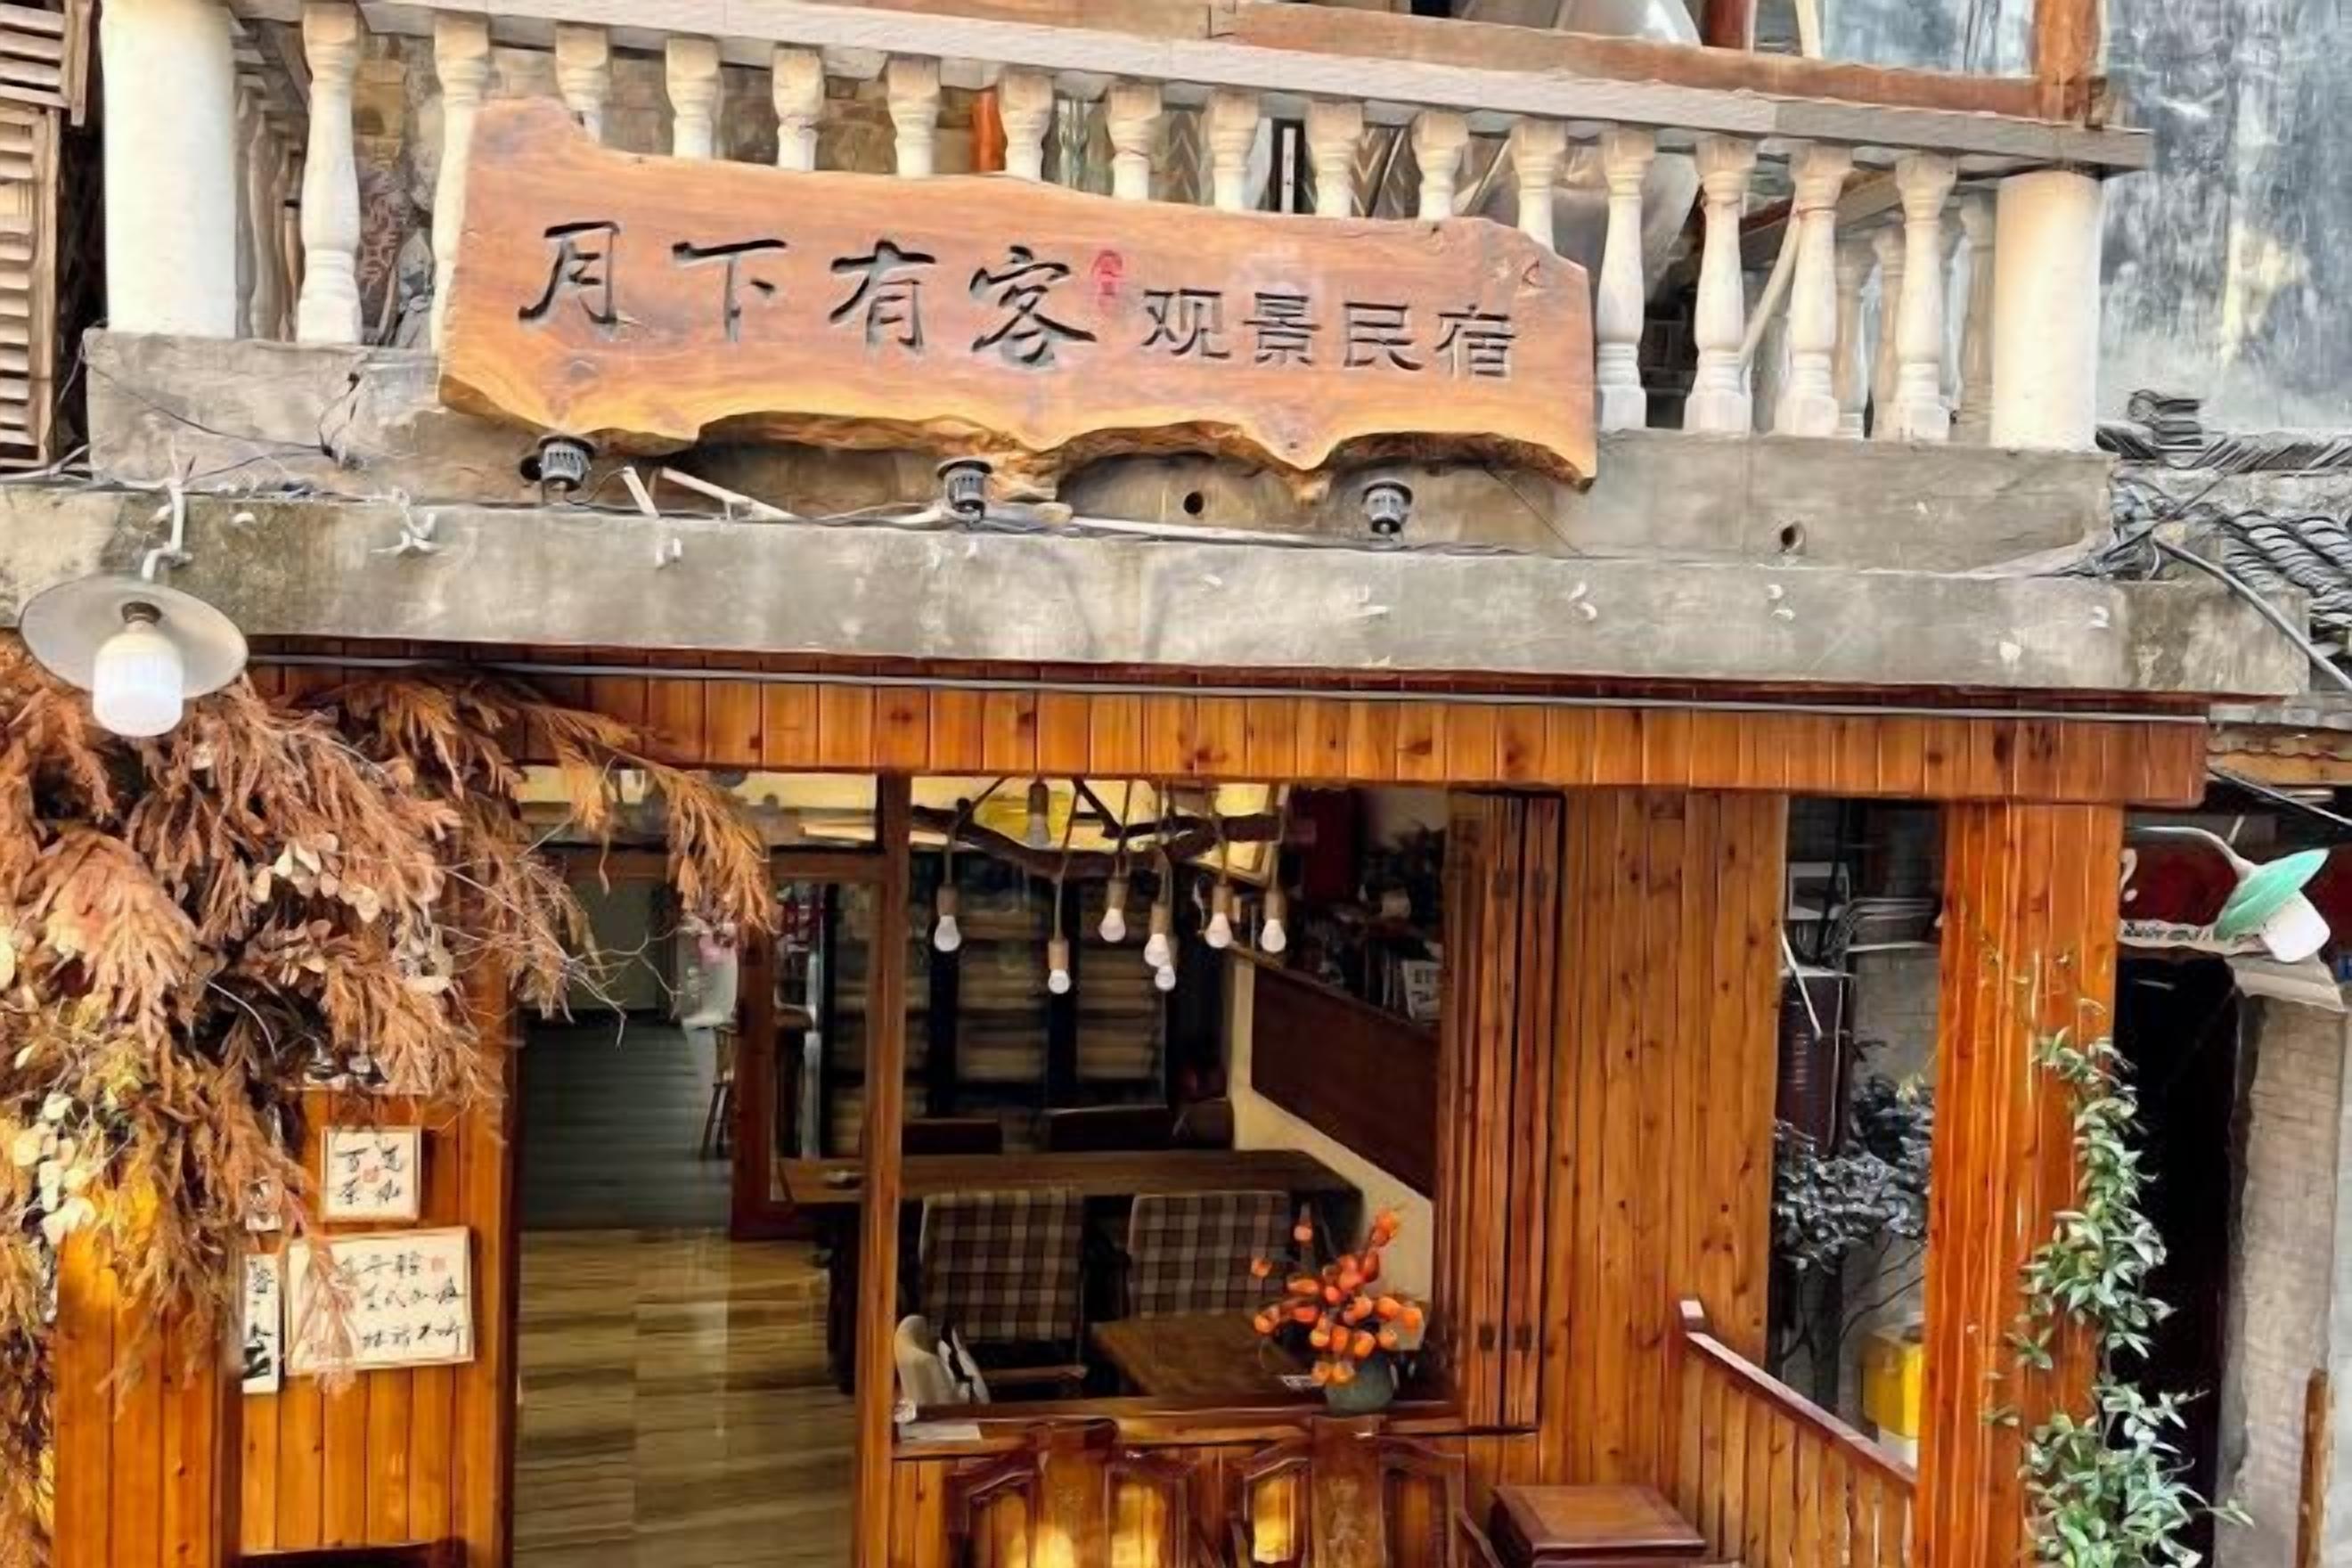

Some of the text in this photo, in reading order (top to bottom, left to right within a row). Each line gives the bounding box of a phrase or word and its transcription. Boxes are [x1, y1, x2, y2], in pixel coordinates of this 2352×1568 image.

[519, 220, 1095, 365] 月下有客
[1142, 288, 1515, 377] 观景民宿
